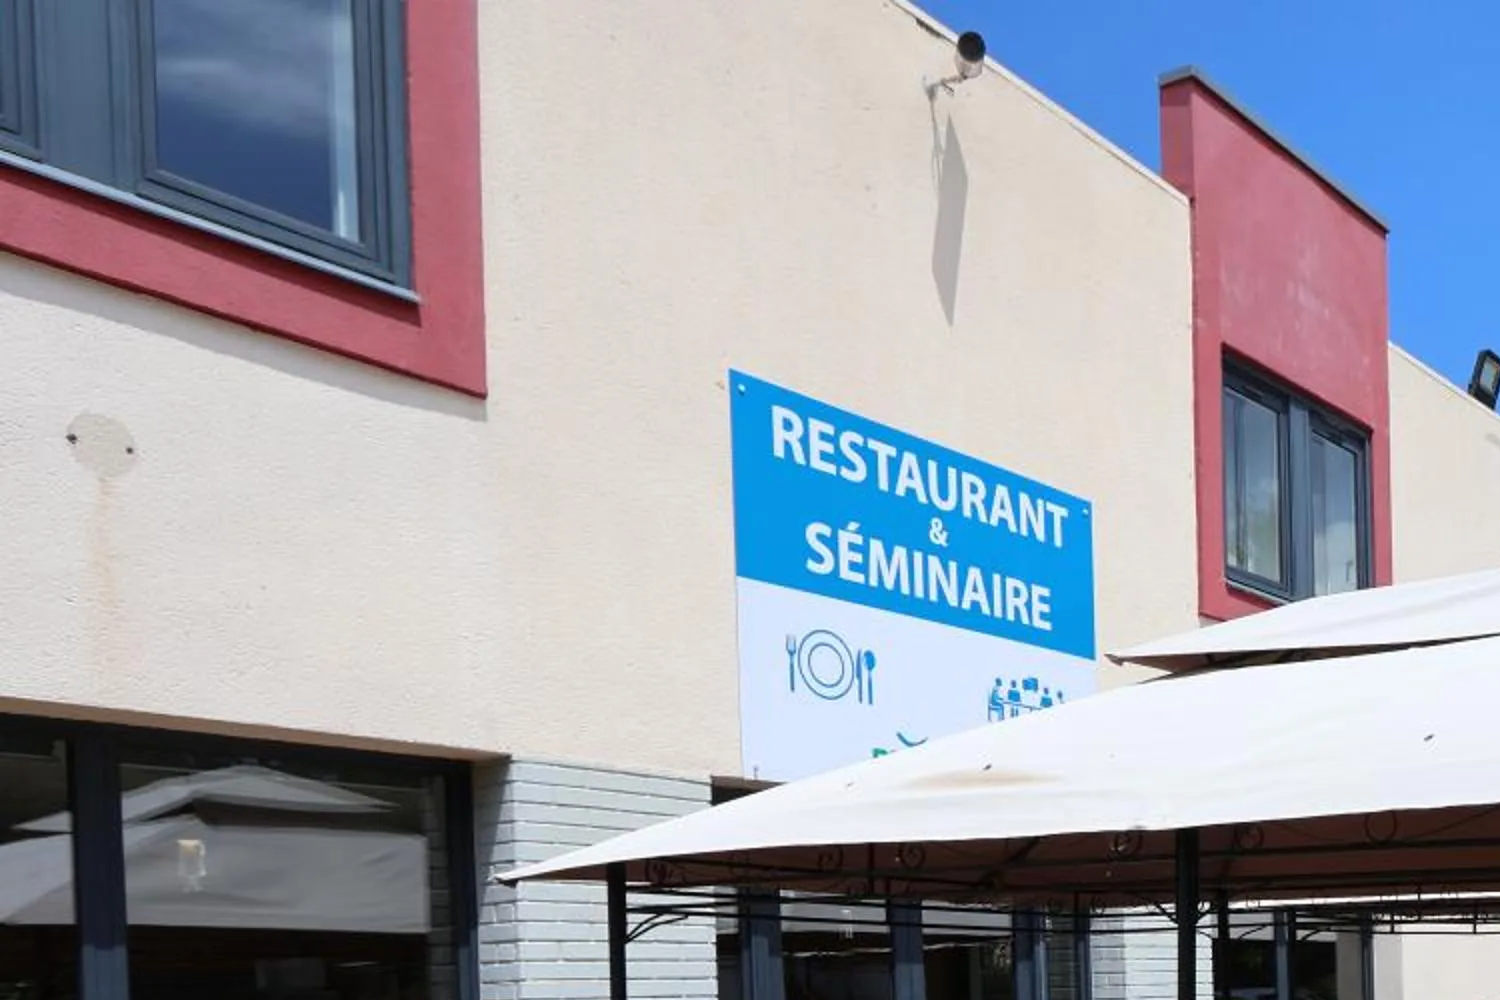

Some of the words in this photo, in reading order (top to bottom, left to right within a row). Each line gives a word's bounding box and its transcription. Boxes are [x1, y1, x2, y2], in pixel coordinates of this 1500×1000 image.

[771, 405, 1069, 548] RESTAURANT
[804, 521, 1053, 631] SÉMINAIRE
[928, 517, 948, 547] &
